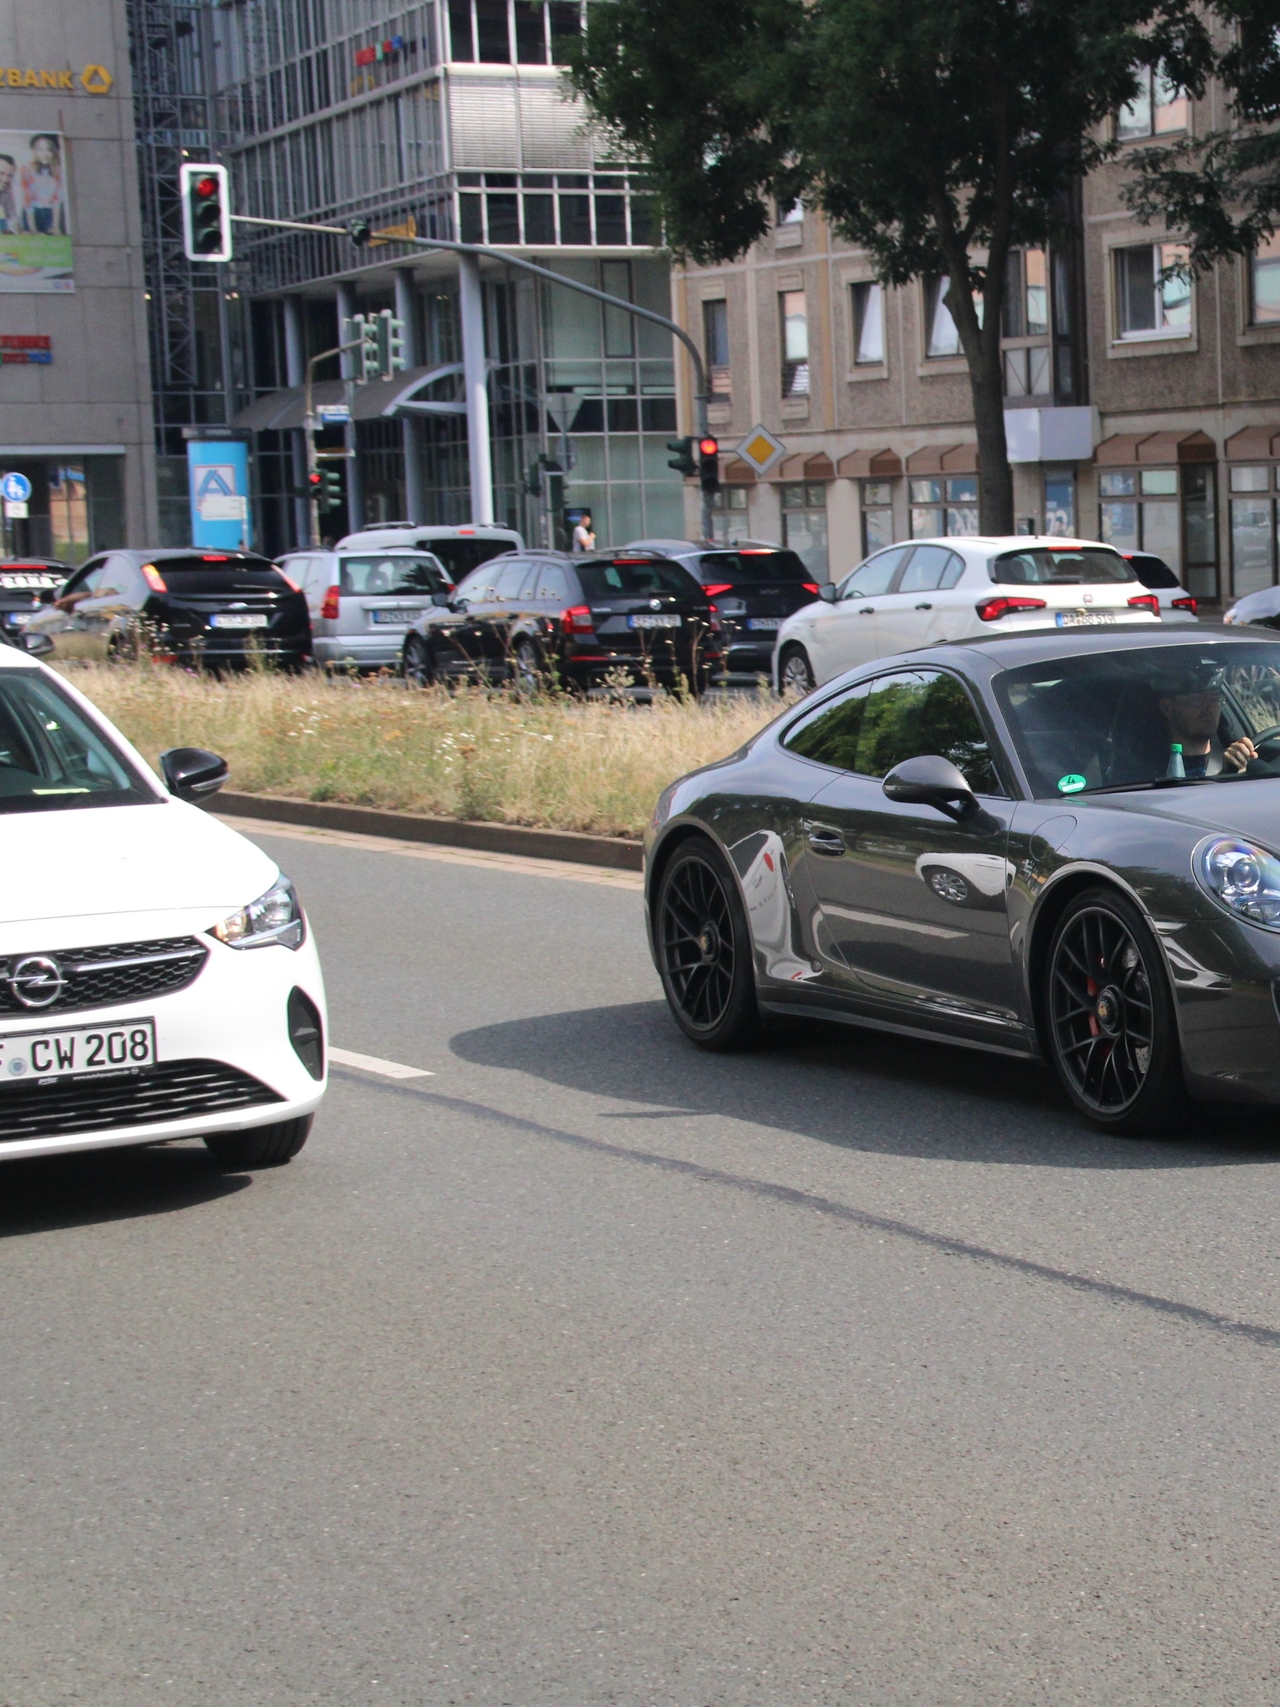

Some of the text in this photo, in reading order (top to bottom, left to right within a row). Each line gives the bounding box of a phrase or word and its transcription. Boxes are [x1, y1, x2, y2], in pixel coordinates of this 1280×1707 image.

[1067, 775, 1075, 784] 4
[31, 1036, 76, 1072] CW
[85, 1028, 149, 1067] 208
